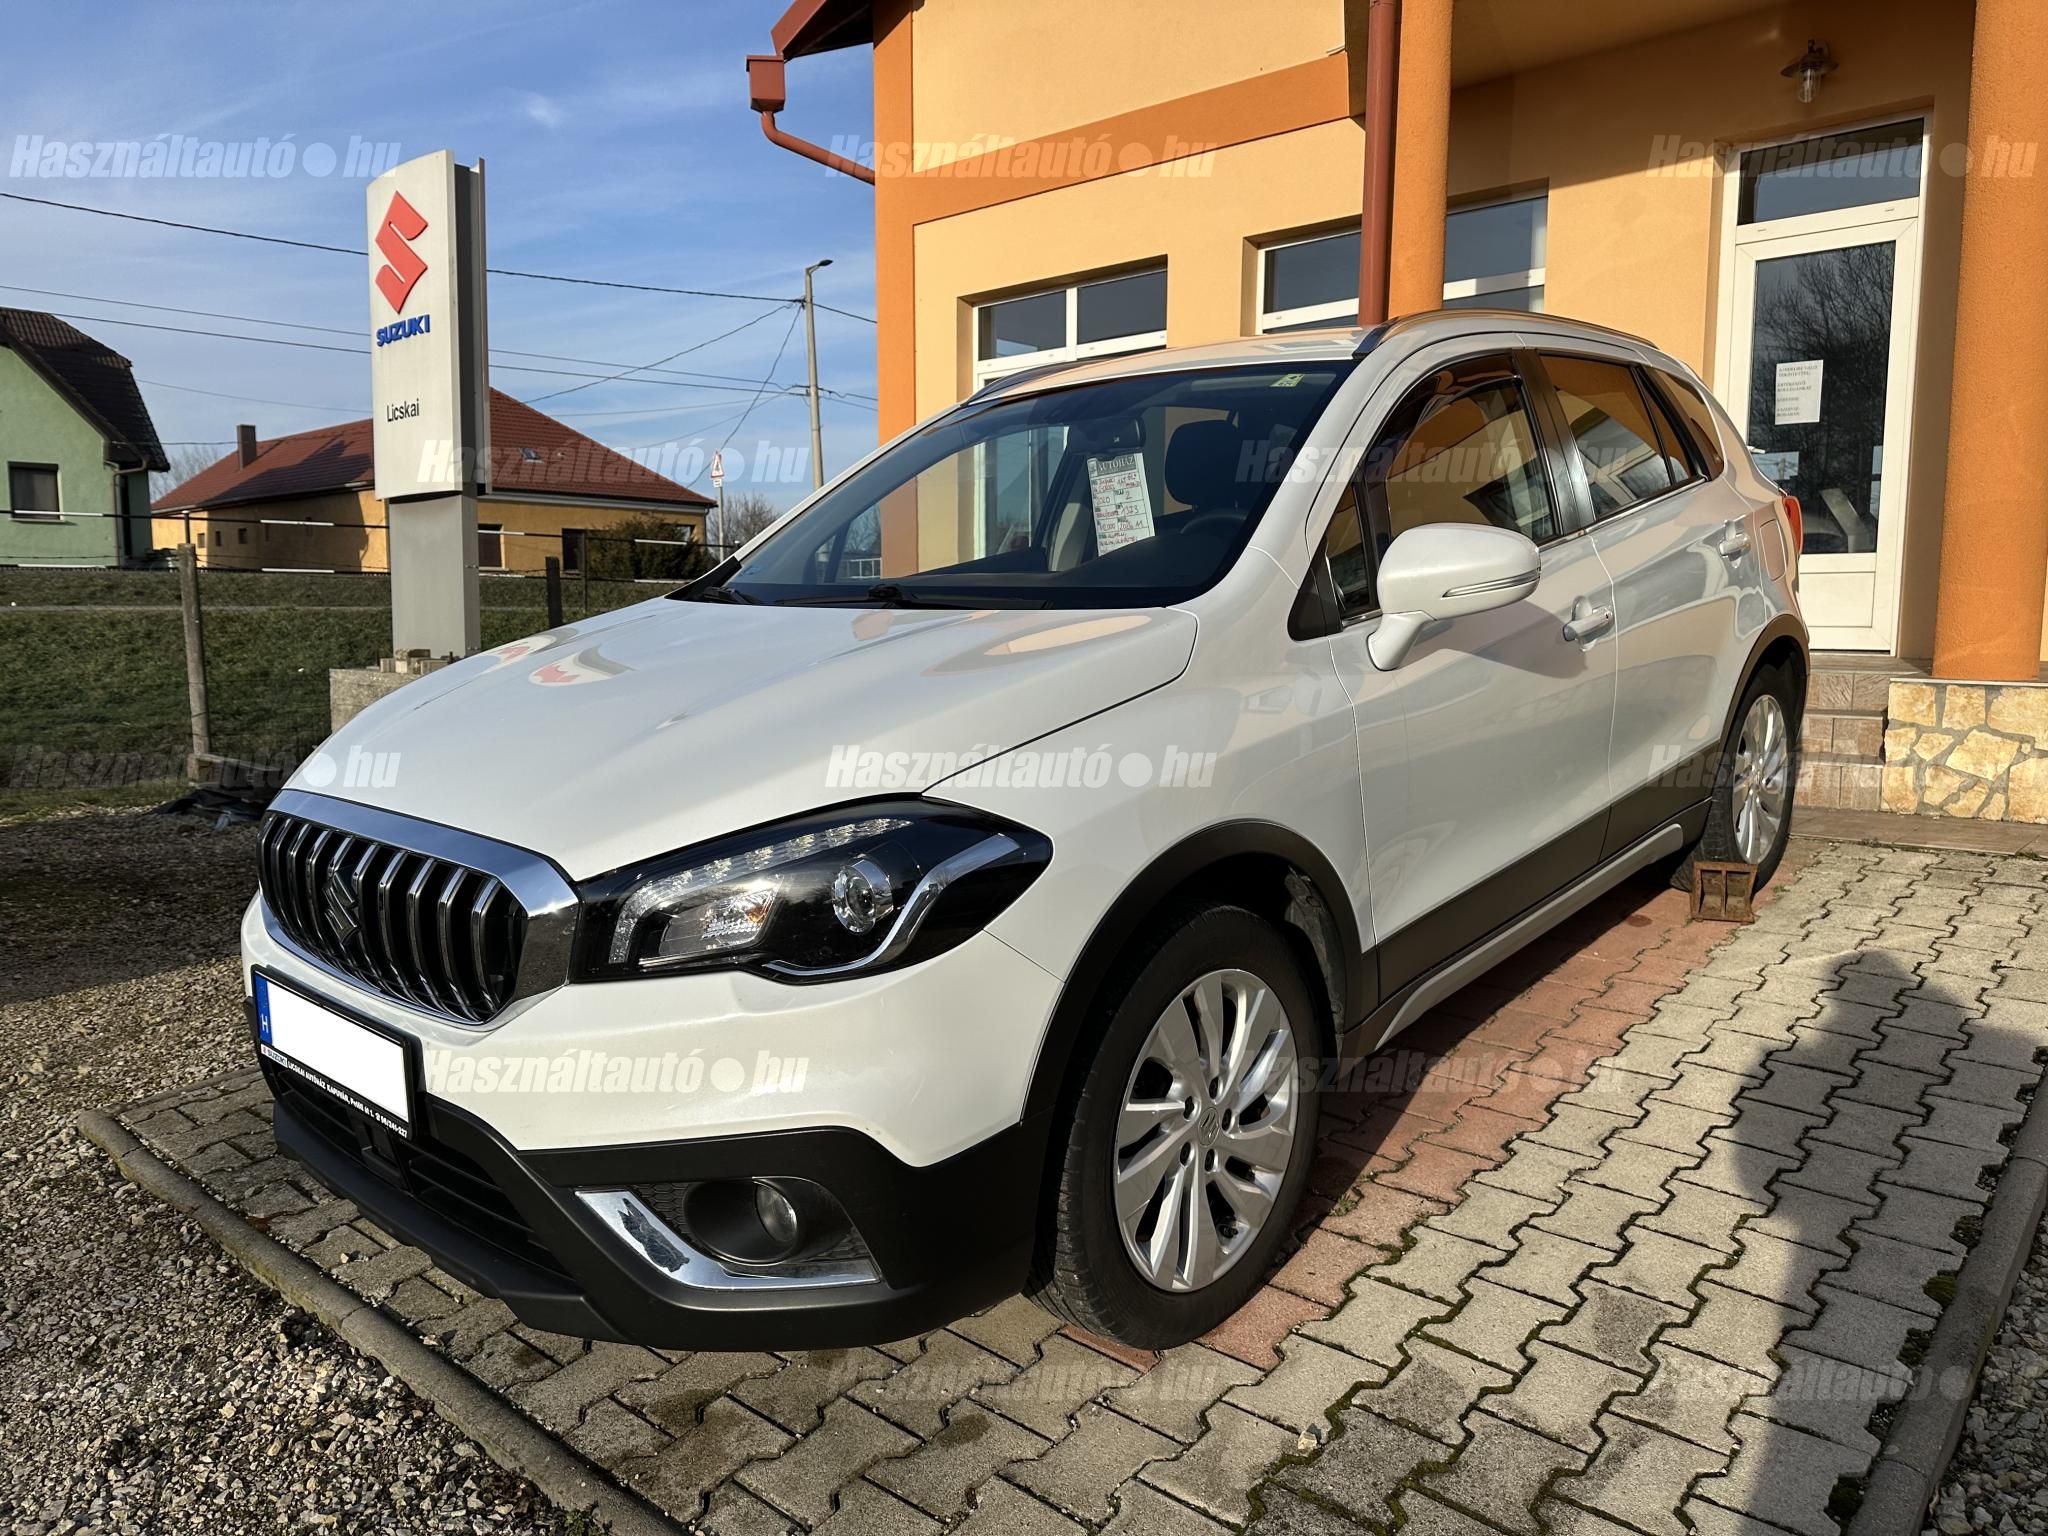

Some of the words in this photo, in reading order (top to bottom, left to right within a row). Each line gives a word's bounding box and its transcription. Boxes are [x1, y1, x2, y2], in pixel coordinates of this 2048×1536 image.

[376, 314, 430, 347] SUZUKI
[386, 398, 420, 422] Licskai
[260, 1013, 269, 1034] H
[267, 1047, 287, 1067] SUZUKI
